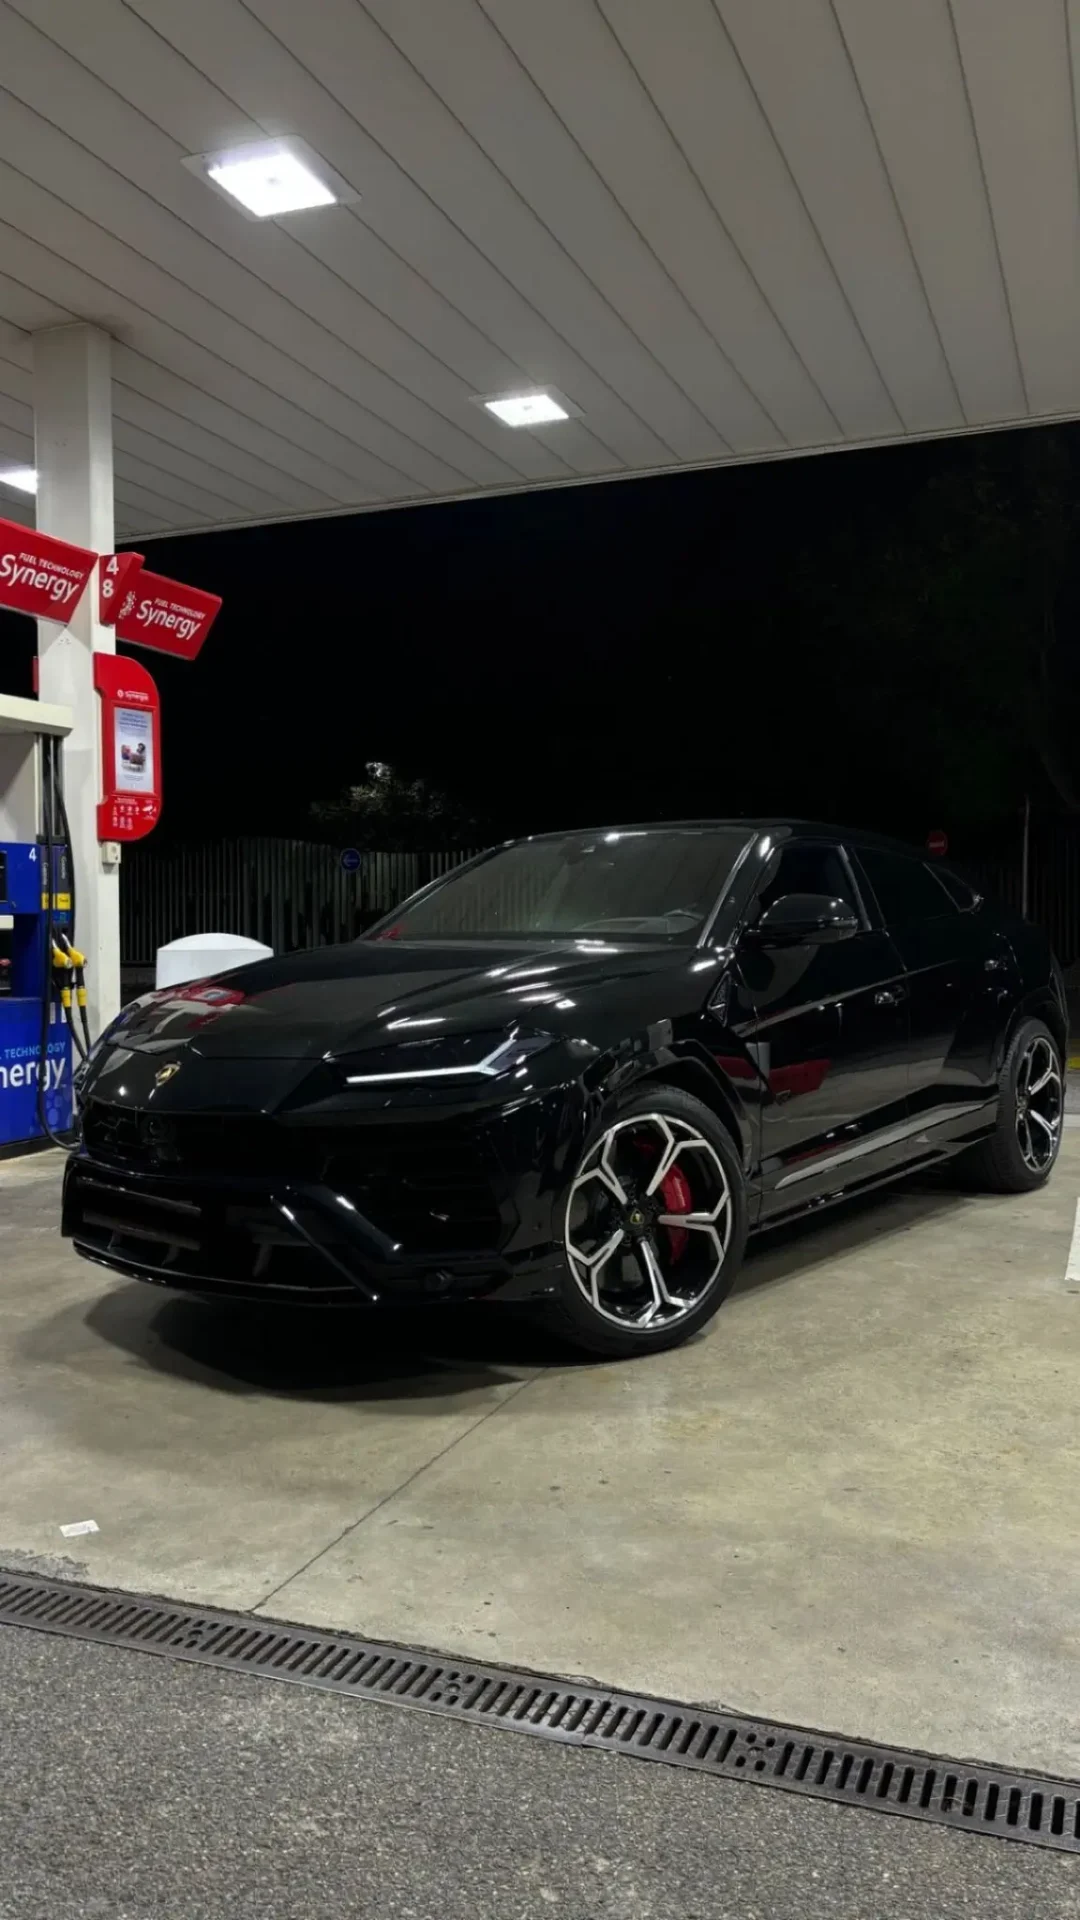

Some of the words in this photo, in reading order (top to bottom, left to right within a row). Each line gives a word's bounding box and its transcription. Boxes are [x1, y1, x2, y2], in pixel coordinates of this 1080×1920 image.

[19, 552, 37, 566] FUEL
[38, 558, 84, 580] TECHNOLOGY
[105, 555, 119, 575] 4
[0, 554, 80, 604] Synergy
[102, 579, 114, 598] 8
[154, 597, 169, 609] FUEL
[169, 602, 206, 621] TECHNOLOGY
[136, 600, 202, 641] Synergy
[28, 847, 38, 862] 4
[4, 1041, 66, 1060] TECHNOOGY
